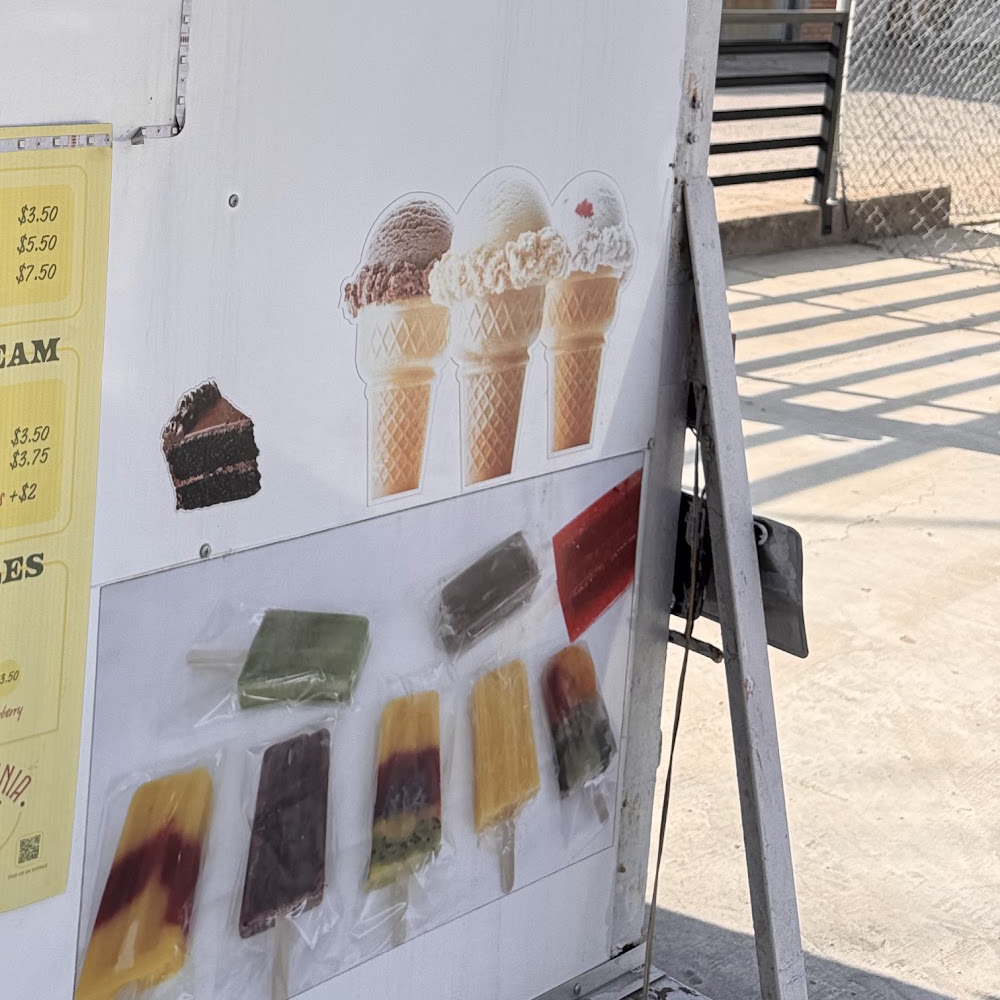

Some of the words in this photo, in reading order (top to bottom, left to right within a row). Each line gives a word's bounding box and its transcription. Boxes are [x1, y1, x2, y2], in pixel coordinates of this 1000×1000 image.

[18, 204, 58, 225] $3.50
[17, 234, 57, 255] $5.50
[16, 263, 57, 284] $7.50
[11, 425, 50, 447] $3.50
[10, 447, 50, 470] $3.75
[9, 483, 37, 503] +$2
